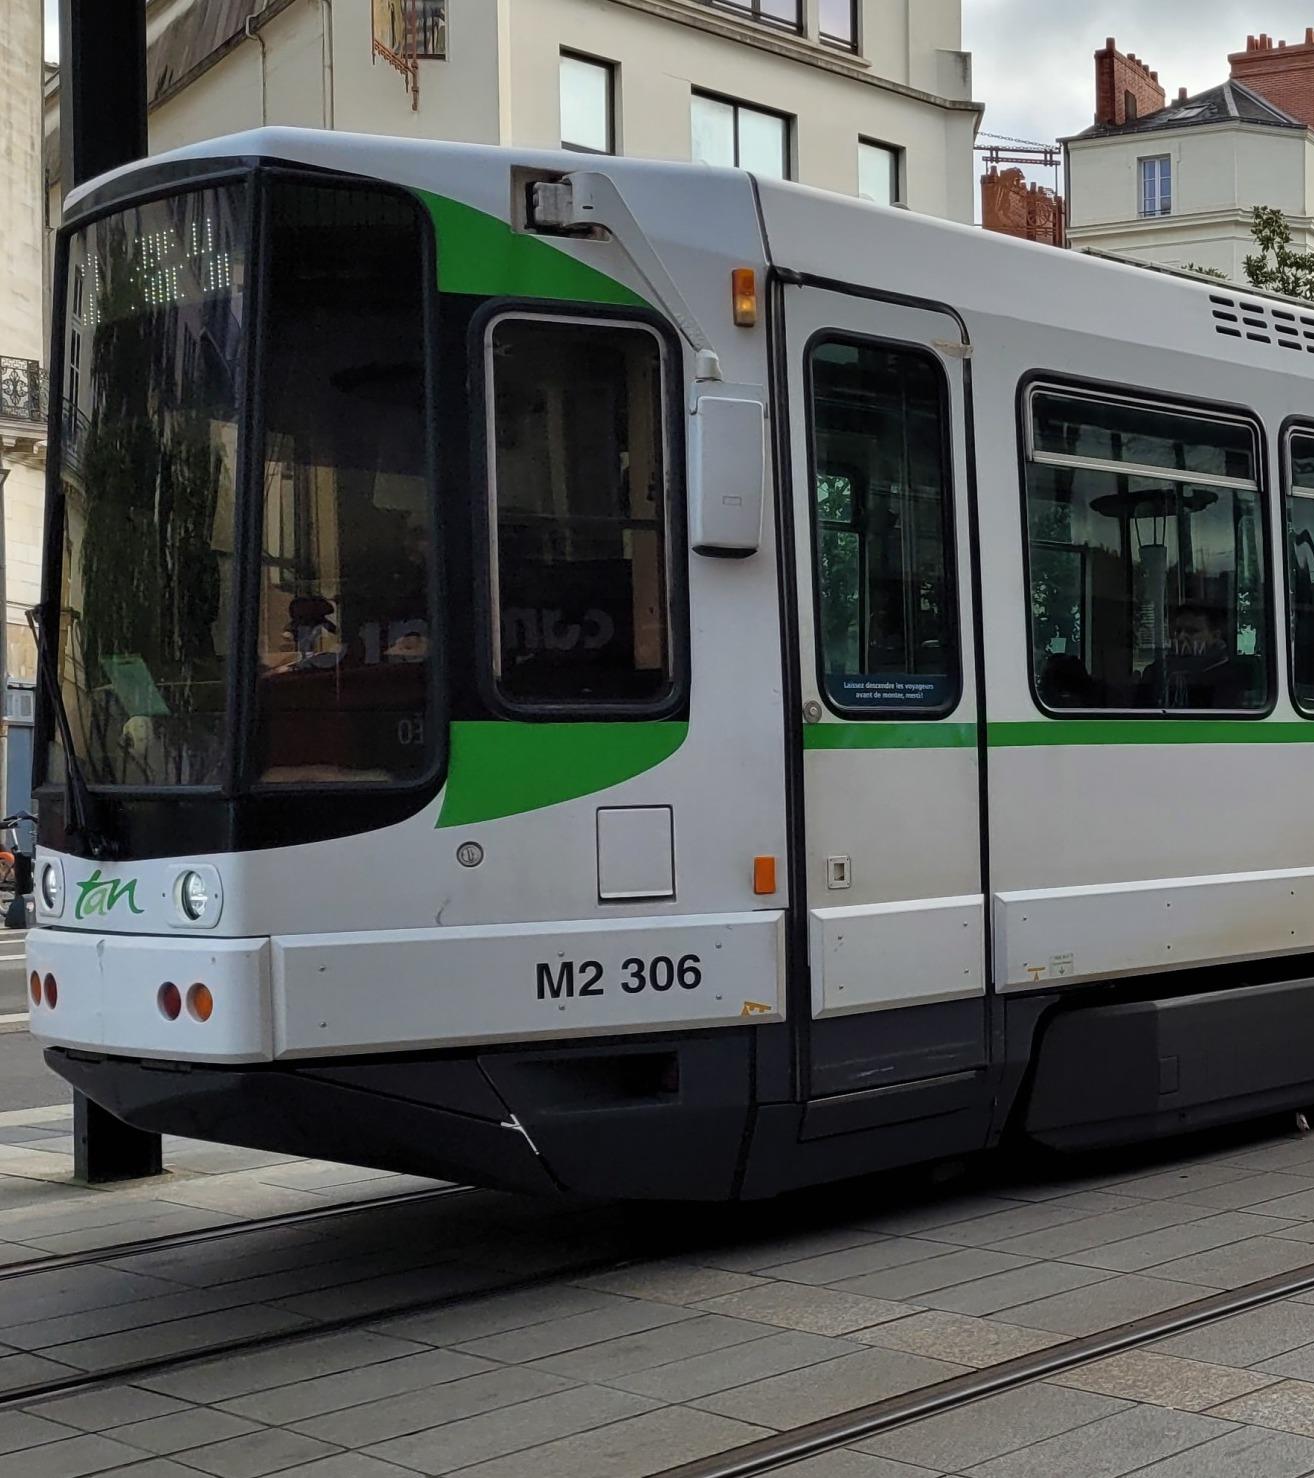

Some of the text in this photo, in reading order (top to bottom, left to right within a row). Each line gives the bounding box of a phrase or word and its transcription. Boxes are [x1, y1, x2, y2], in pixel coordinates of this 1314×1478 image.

[843, 681, 934, 691] Laissez descendre les voyageurs
[855, 691, 873, 699] avant
[873, 691, 882, 699] de
[75, 869, 145, 920] tan
[536, 954, 702, 1000] M2 306
